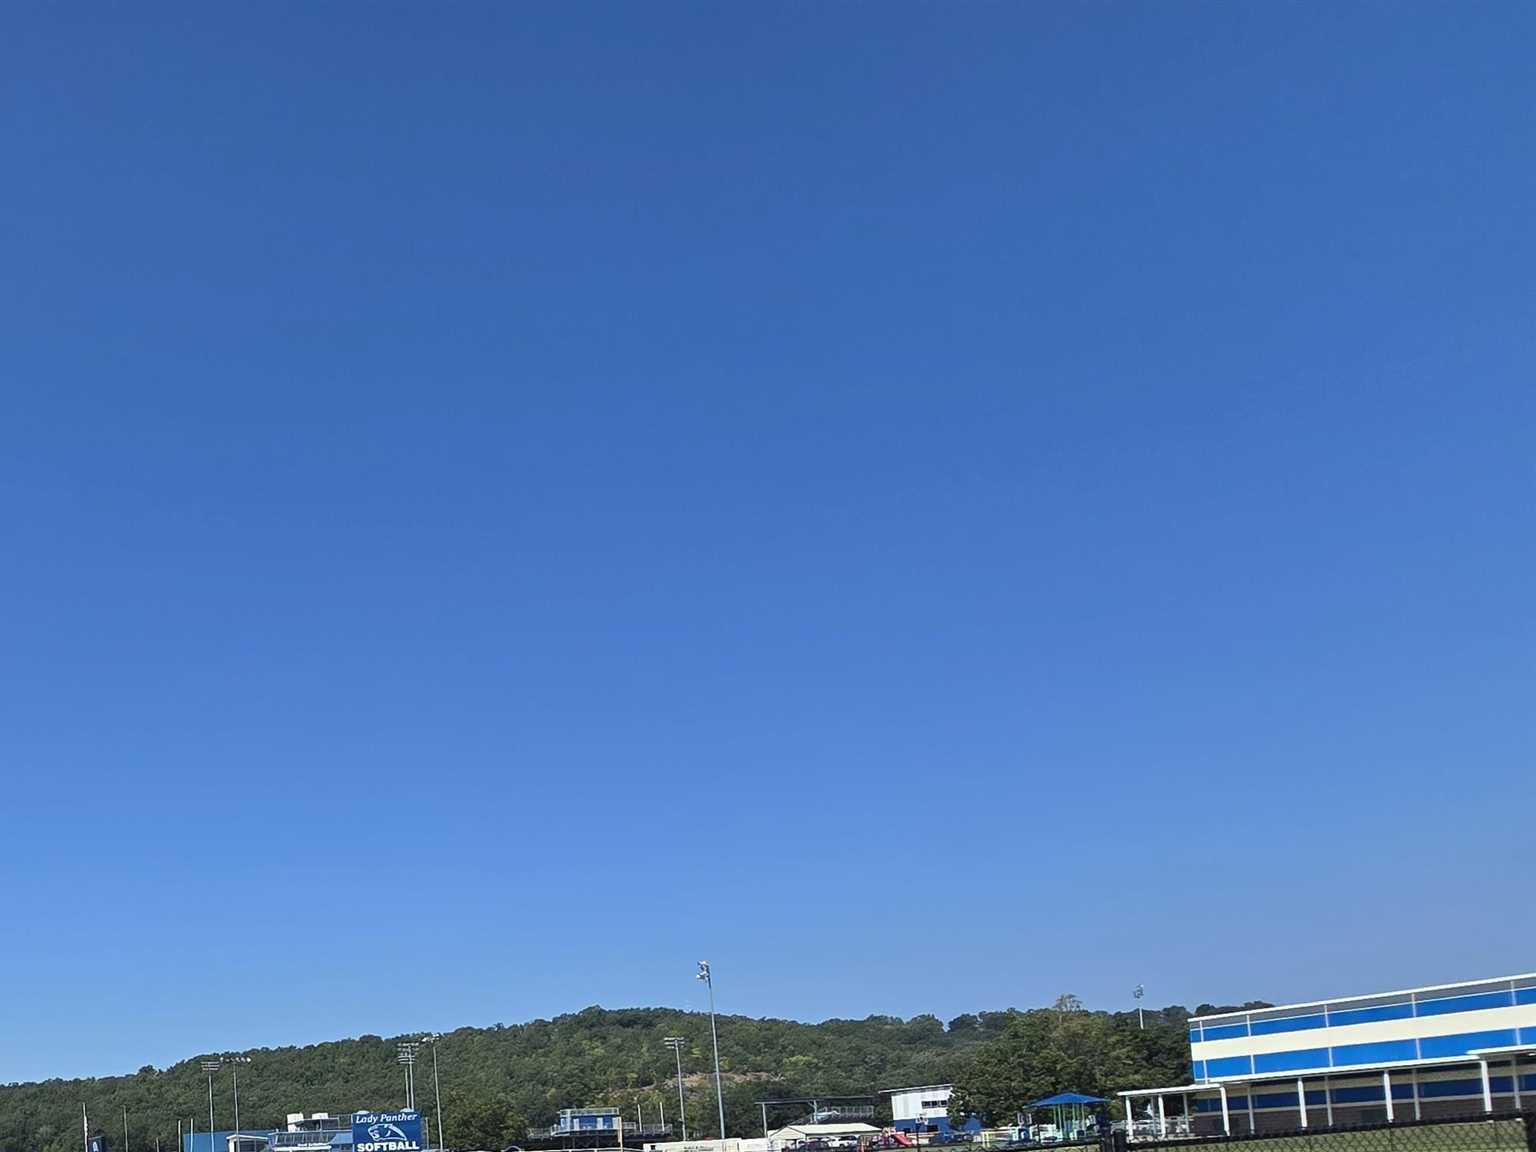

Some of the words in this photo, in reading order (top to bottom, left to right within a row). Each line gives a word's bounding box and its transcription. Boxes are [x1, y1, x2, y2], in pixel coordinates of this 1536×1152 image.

[356, 1115, 378, 1124] Lady
[380, 1113, 418, 1122] Panther
[357, 1141, 420, 1152] SOFTBALL
